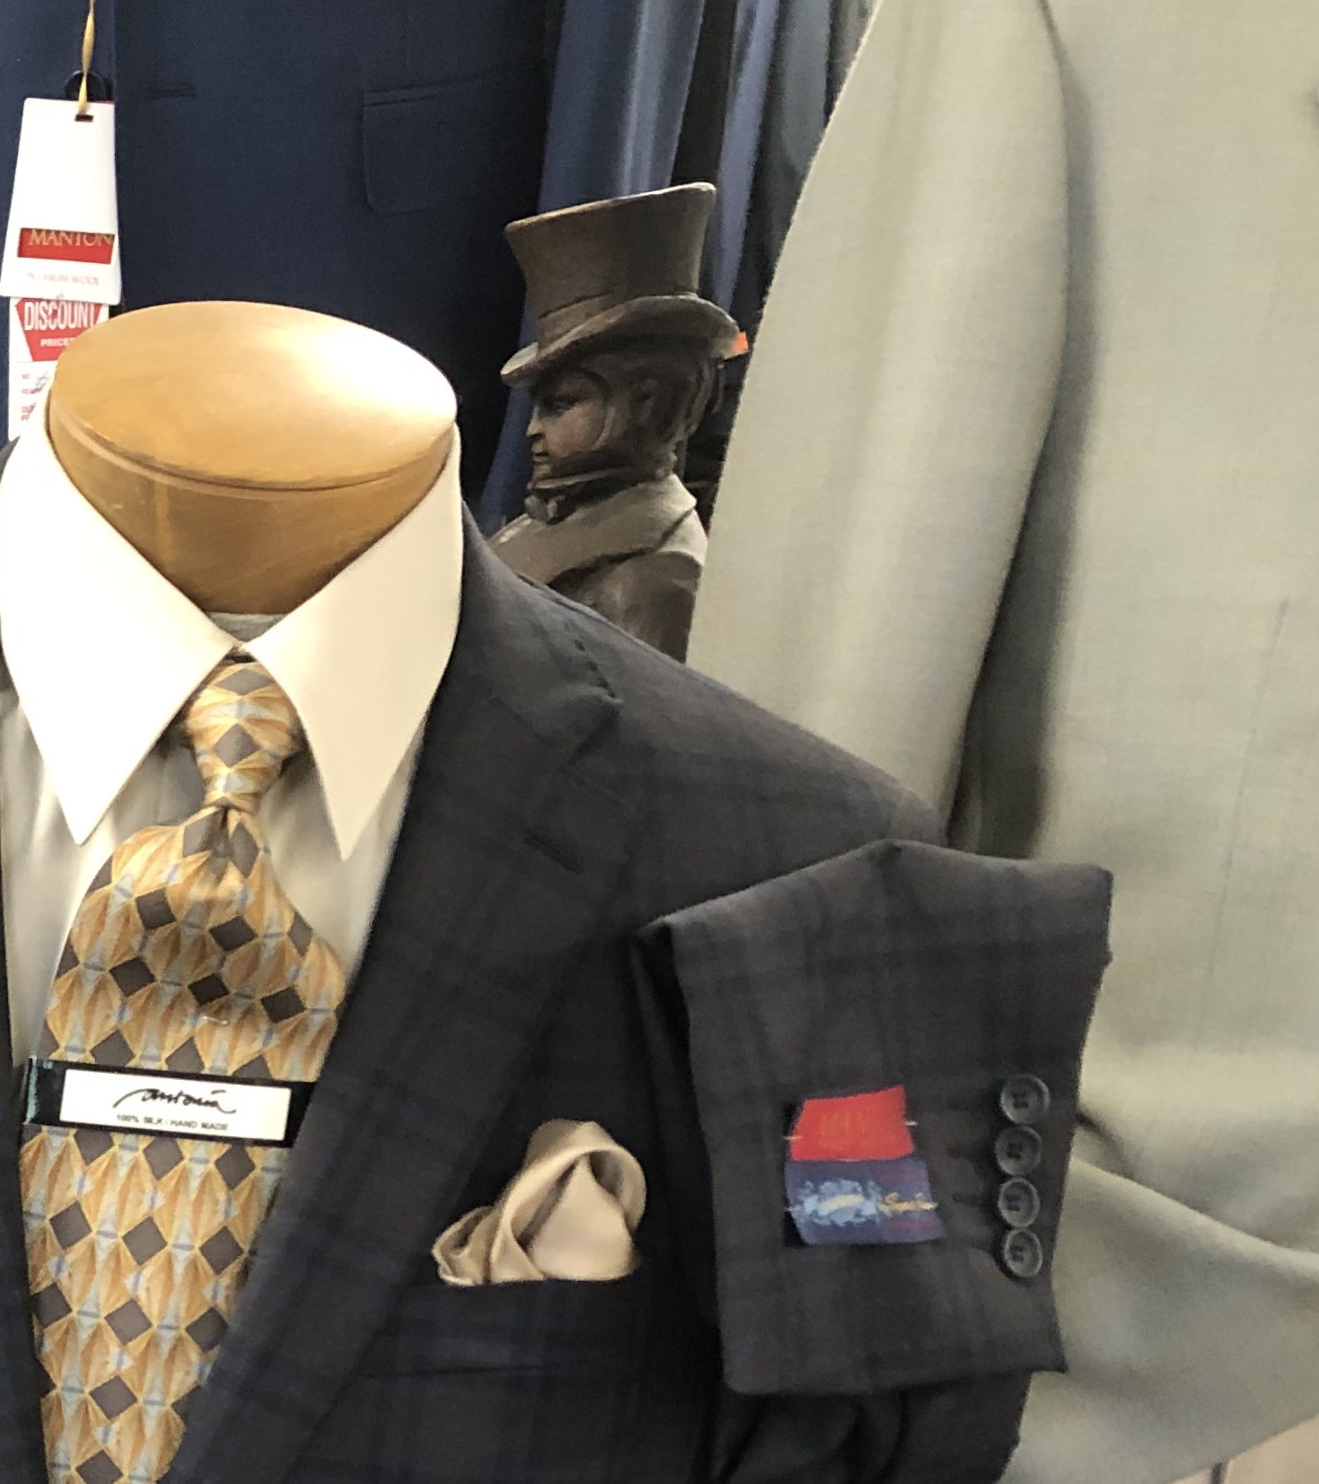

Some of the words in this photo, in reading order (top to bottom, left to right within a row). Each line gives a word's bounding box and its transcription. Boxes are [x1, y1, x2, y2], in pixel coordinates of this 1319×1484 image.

[23, 300, 96, 331] DISCOUNT
[143, 1117, 163, 1125] SILK
[170, 1120, 198, 1129] HAND
[201, 1123, 228, 1131] MADE
